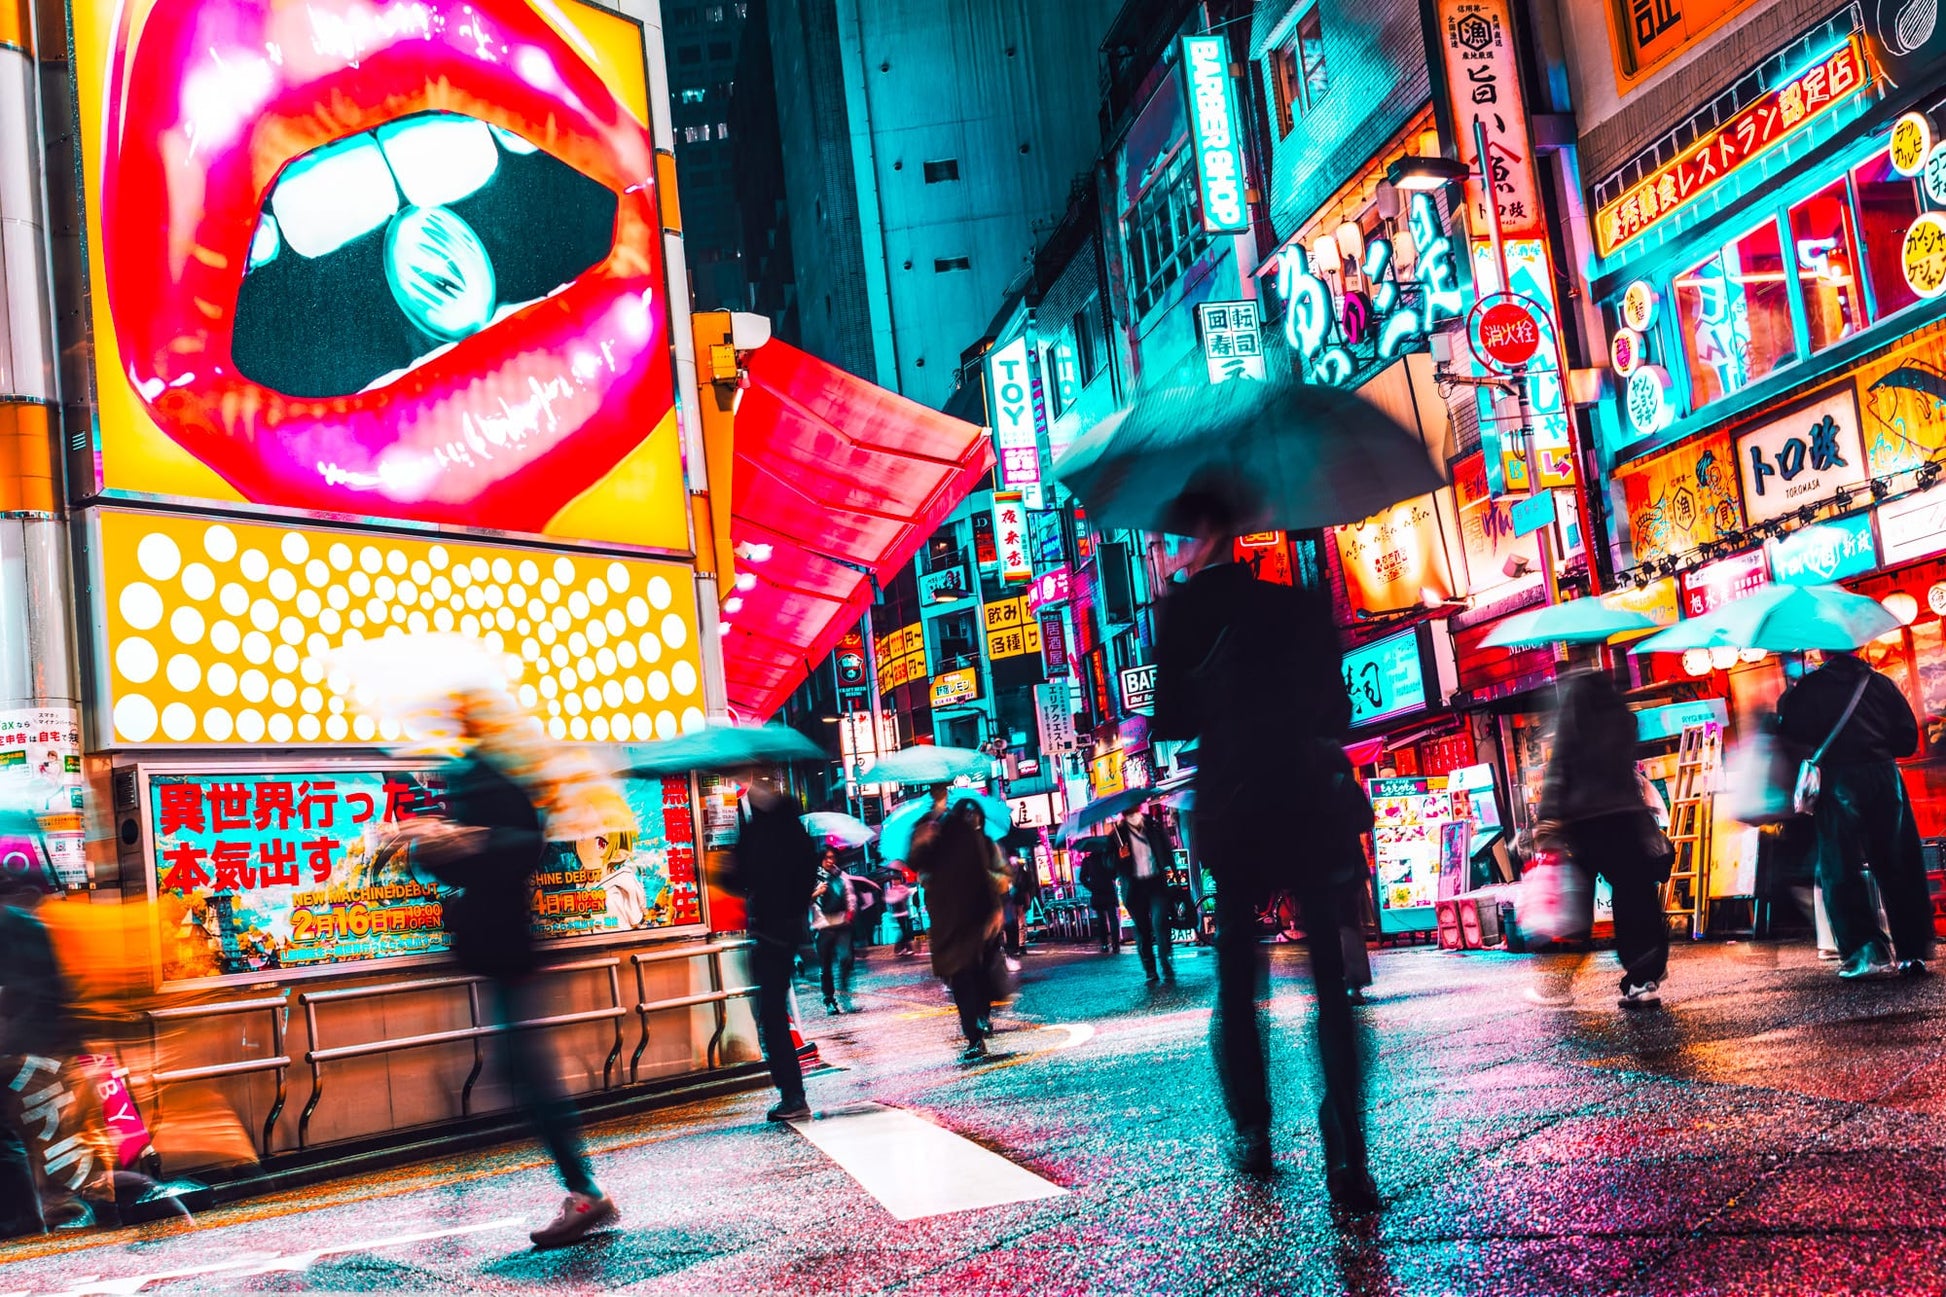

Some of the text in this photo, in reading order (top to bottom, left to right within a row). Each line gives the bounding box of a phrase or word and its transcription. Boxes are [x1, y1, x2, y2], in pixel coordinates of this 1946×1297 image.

[1463, 20, 1487, 44] 漁
[1190, 41, 1241, 225] BARBER SHOP
[1604, 48, 1853, 248] 優秀韓食レストラン認定店
[1206, 308, 1254, 330] 回転
[1210, 333, 1256, 355] 寿司
[1484, 322, 1536, 348] 消火栓
[998, 360, 1025, 426] TOY
[1785, 479, 1820, 499] TOROMASA
[1001, 508, 1022, 567] 夜来香
[1046, 621, 1064, 665] 居酒屋
[1049, 686, 1064, 751] エリアクエスト
[163, 836, 340, 895] 本気出す
[564, 868, 602, 884] DEBUT
[292, 883, 439, 907] NEW MACHINE DEBUT
[577, 900, 605, 913] OPEN
[408, 904, 442, 918] 10:00
[409, 915, 442, 931] OPEN
